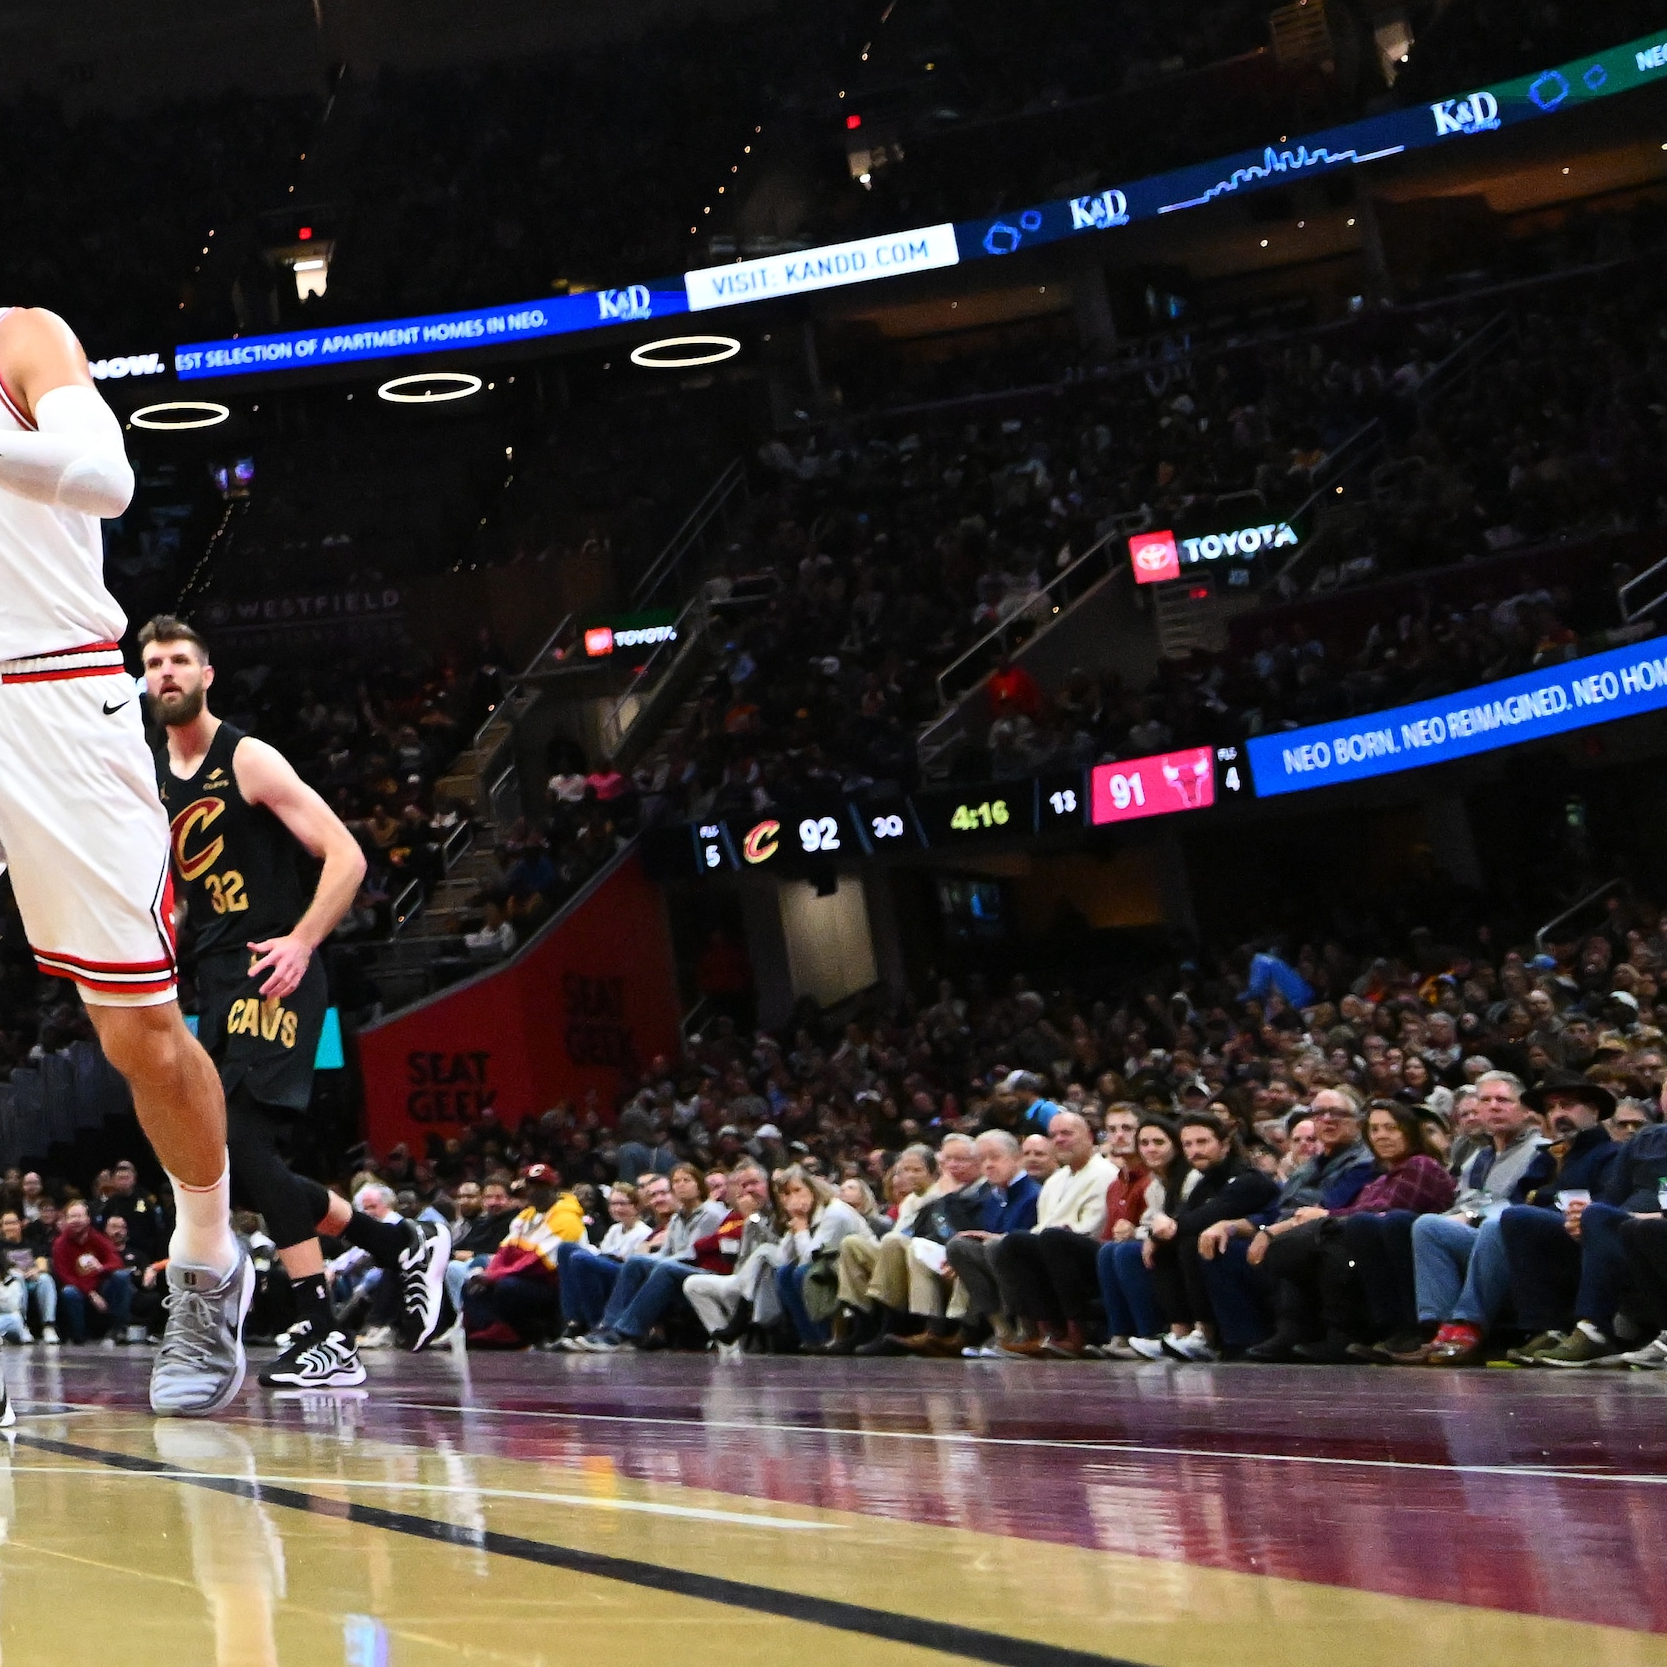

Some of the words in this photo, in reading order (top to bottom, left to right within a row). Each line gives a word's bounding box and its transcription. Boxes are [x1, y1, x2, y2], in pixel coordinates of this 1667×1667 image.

[1430, 91, 1501, 136] K&D
[1069, 189, 1129, 230] K&D
[710, 268, 780, 298] VISIT:
[784, 238, 931, 286] KANDD.COM
[596, 284, 652, 320] K&D
[206, 341, 293, 369] SELECTION
[294, 336, 318, 358] OF
[321, 326, 422, 355] APARTMENT
[423, 319, 485, 343] HOMES
[486, 316, 507, 335] IN
[1184, 521, 1299, 564] TOYOTA
[1282, 741, 1332, 775] NEO
[1334, 726, 1402, 765] BORN.
[1402, 716, 1447, 750] NEO
[1447, 684, 1574, 740] REIMAGINED.
[1573, 671, 1620, 708] NEO
[1109, 771, 1147, 810] 91
[1225, 766, 1241, 792] 4
[798, 816, 841, 853] 92
[950, 799, 1011, 833] 4:16
[705, 844, 721, 869] 5
[204, 868, 250, 915] 32
[227, 995, 299, 1049] CAVS
[406, 1050, 492, 1088] SEAT
